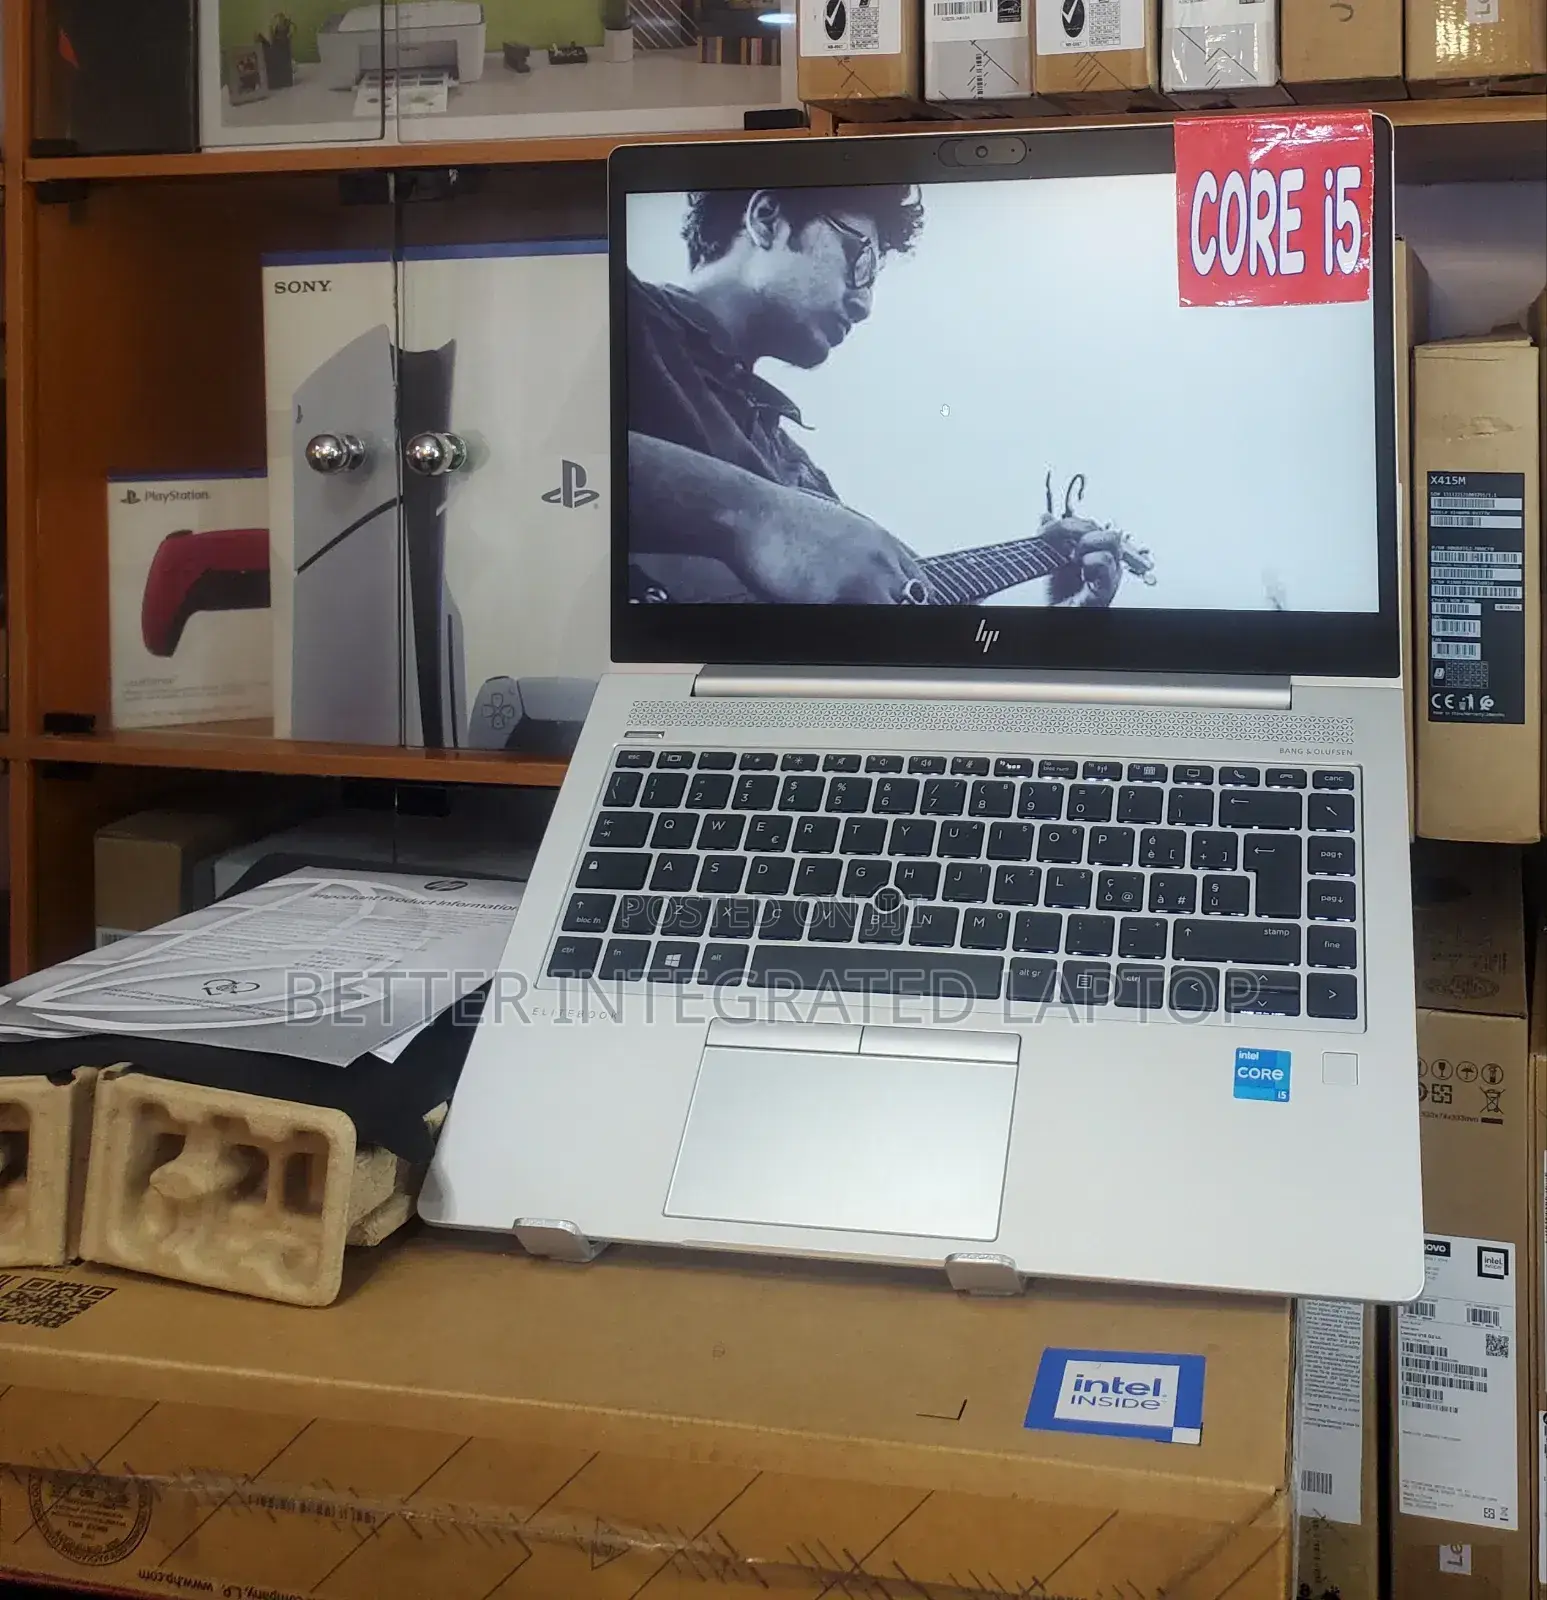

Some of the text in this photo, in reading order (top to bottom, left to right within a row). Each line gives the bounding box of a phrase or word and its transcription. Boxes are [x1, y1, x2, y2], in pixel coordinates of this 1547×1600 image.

[1190, 166, 1362, 276] CORE i5
[274, 280, 330, 294] SONY
[1430, 476, 1466, 485] X415M
[144, 490, 209, 504] PlayStation
[974, 618, 1000, 653] hp
[1279, 747, 1304, 755] BANG
[1313, 748, 1353, 756] OLUFSEN
[746, 780, 753, 788] £
[791, 782, 797, 790] $
[838, 783, 846, 791] %
[884, 783, 891, 791] &
[835, 796, 841, 804] 5
[882, 797, 889, 805] 6
[979, 800, 986, 808] 8
[1027, 802, 1035, 810] 9
[664, 820, 674, 828] Q
[712, 821, 725, 830] W
[757, 822, 766, 831] E
[804, 824, 813, 833] R
[853, 825, 860, 834] T
[902, 826, 910, 835] Y
[950, 829, 959, 837] U
[1049, 833, 1059, 841] O
[1099, 835, 1107, 844] P
[1320, 850, 1336, 859] pag
[663, 862, 672, 870] A
[711, 863, 719, 872] S
[758, 864, 767, 873] D
[806, 866, 815, 875] F
[856, 867, 865, 876] G
[905, 869, 914, 878] H
[954, 871, 961, 880] J
[1005, 874, 1014, 883] K
[1056, 877, 1063, 886] L
[1122, 892, 1133, 902] @
[1320, 895, 1337, 903] pag
[674, 905, 684, 914] Z
[723, 907, 733, 916] X
[772, 909, 782, 918] C
[822, 910, 832, 920] V
[870, 915, 880, 924] B
[922, 915, 932, 925] N
[974, 917, 985, 927] M
[1263, 927, 1290, 937] stamp
[1324, 940, 1341, 949] fine
[711, 953, 722, 961] alt
[1019, 968, 1041, 978] alt gr
[1238, 1050, 1260, 1060] intel
[1484, 1256, 1503, 1265] intel
[1073, 1373, 1162, 1397] intel
[137, 1568, 214, 1592] www.hp.com
